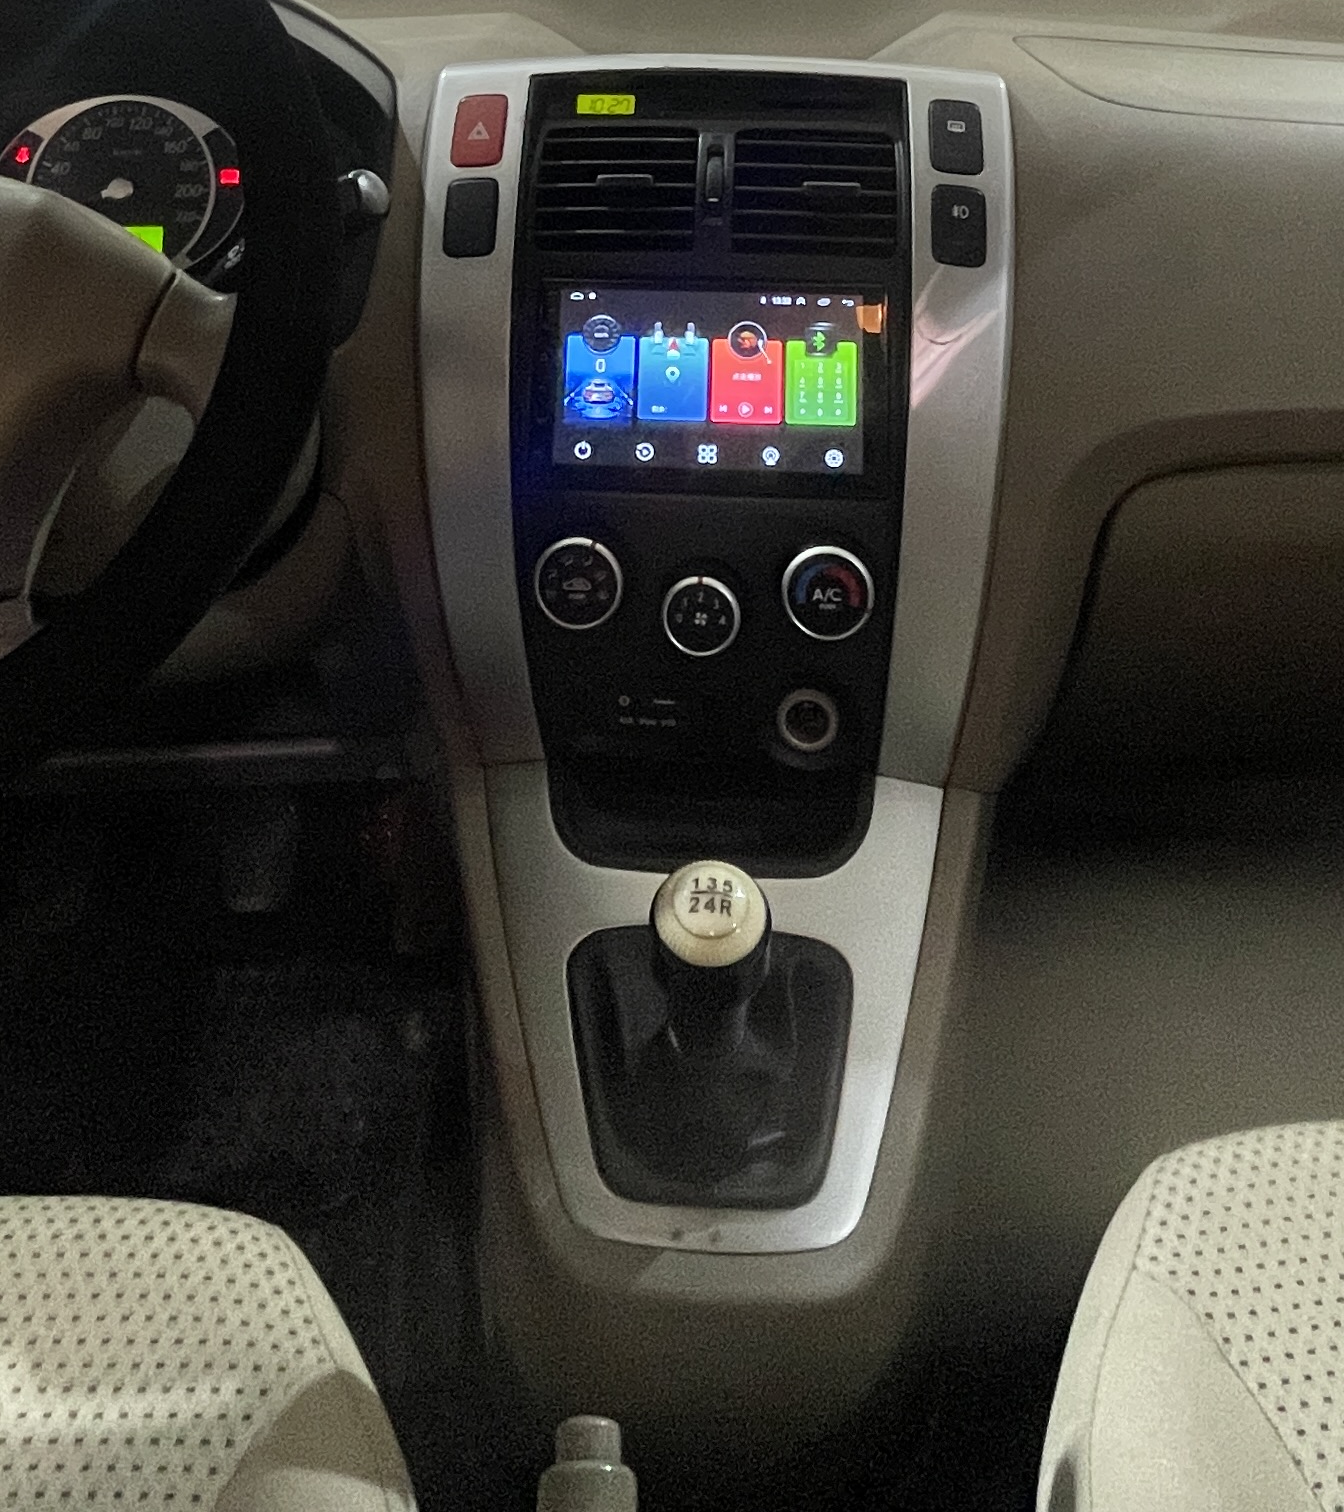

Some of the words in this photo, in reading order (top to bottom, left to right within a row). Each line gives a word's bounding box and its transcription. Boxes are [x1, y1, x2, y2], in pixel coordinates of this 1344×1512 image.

[81, 126, 103, 140] 80
[164, 140, 189, 154] 160
[174, 184, 203, 198] 200
[595, 358, 606, 373] 0
[812, 588, 842, 602] A/C
